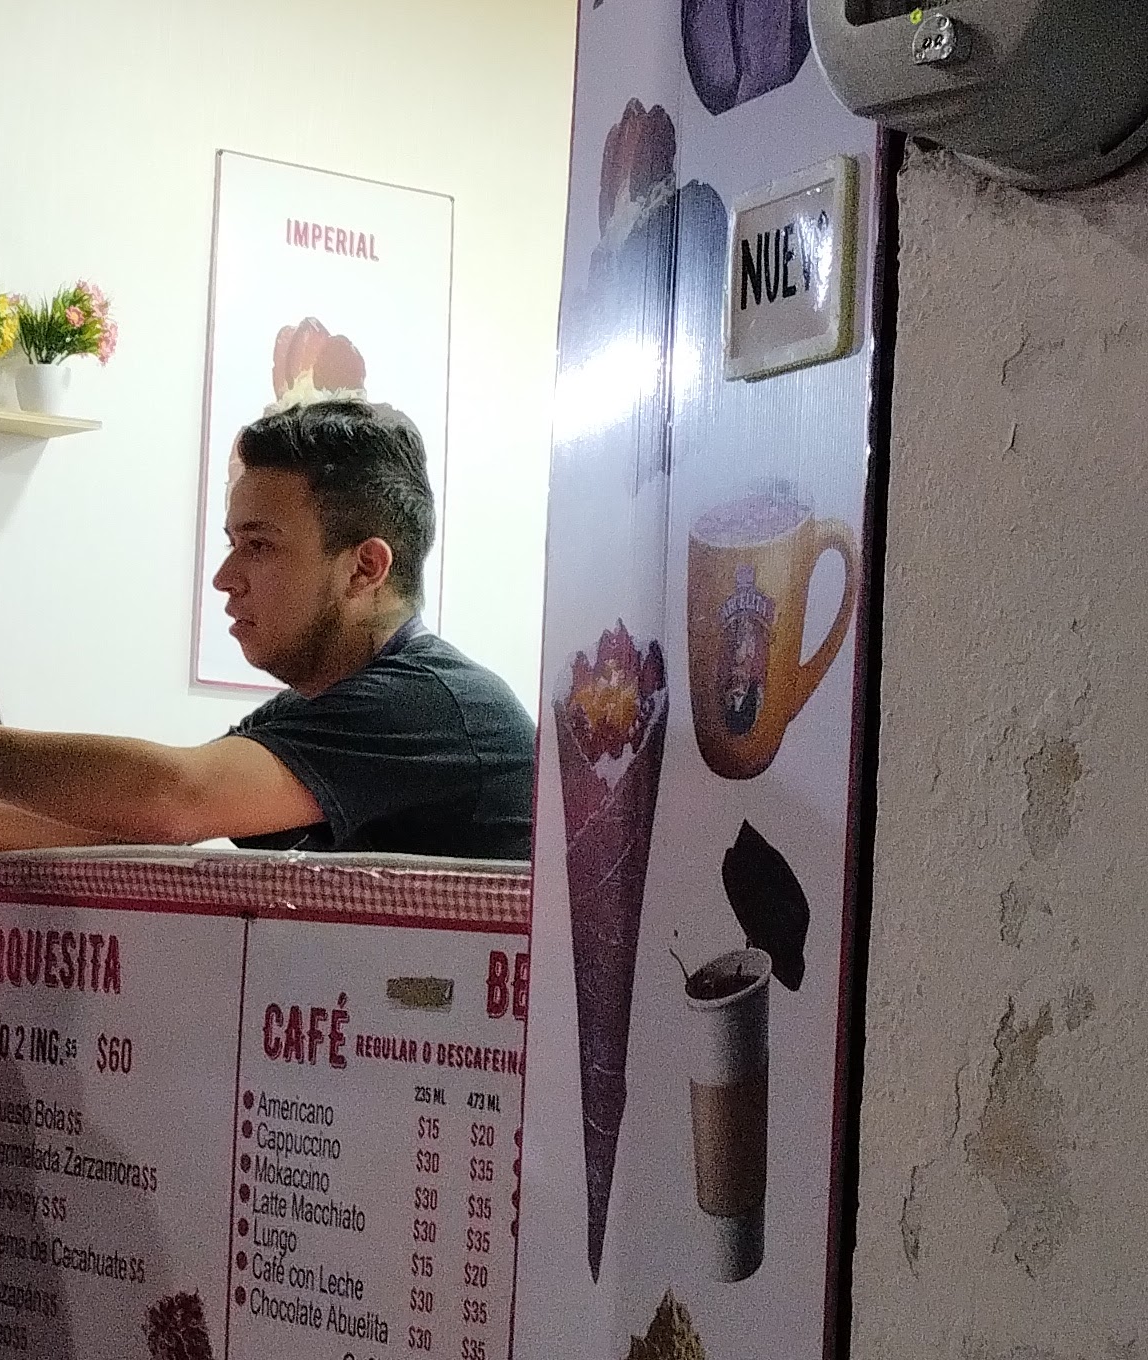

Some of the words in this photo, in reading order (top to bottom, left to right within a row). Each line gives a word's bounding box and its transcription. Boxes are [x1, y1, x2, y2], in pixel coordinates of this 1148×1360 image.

[286, 217, 380, 262] IMPERIAL
[15, 1026, 25, 1061] 2
[30, 1028, 64, 1066] ING.
[96, 1033, 132, 1074] $60
[263, 992, 350, 1070] CAFÉ
[356, 1034, 417, 1064] REGULAR
[35, 1099, 65, 1131] Bola
[257, 1091, 334, 1126] Americano
[417, 1116, 440, 1140] $15
[471, 1123, 494, 1147] $20
[467, 1092, 485, 1111] 473
[64, 1145, 141, 1189] Zarzamora
[256, 1122, 341, 1160] Cappuccino
[416, 1149, 440, 1174] $30
[469, 1157, 494, 1182] $35
[254, 1155, 330, 1193] Mokaccino
[414, 1186, 437, 1211] $30
[467, 1194, 492, 1220] $35
[252, 1187, 287, 1218] Latte
[291, 1192, 366, 1233] Macchiato
[413, 1218, 436, 1244] $30
[466, 1228, 490, 1254] $35
[52, 1237, 128, 1281] Cacahuate
[252, 1217, 297, 1257] Lungo
[411, 1252, 433, 1278] $15
[464, 1262, 488, 1289] $20
[252, 1252, 284, 1284] Café
[288, 1265, 314, 1289] con
[319, 1265, 364, 1301] Leche
[410, 1287, 433, 1314] $30
[463, 1298, 487, 1325] $35
[250, 1287, 322, 1330] Chocolate
[326, 1304, 389, 1344] Abuelita
[408, 1326, 432, 1352] $30
